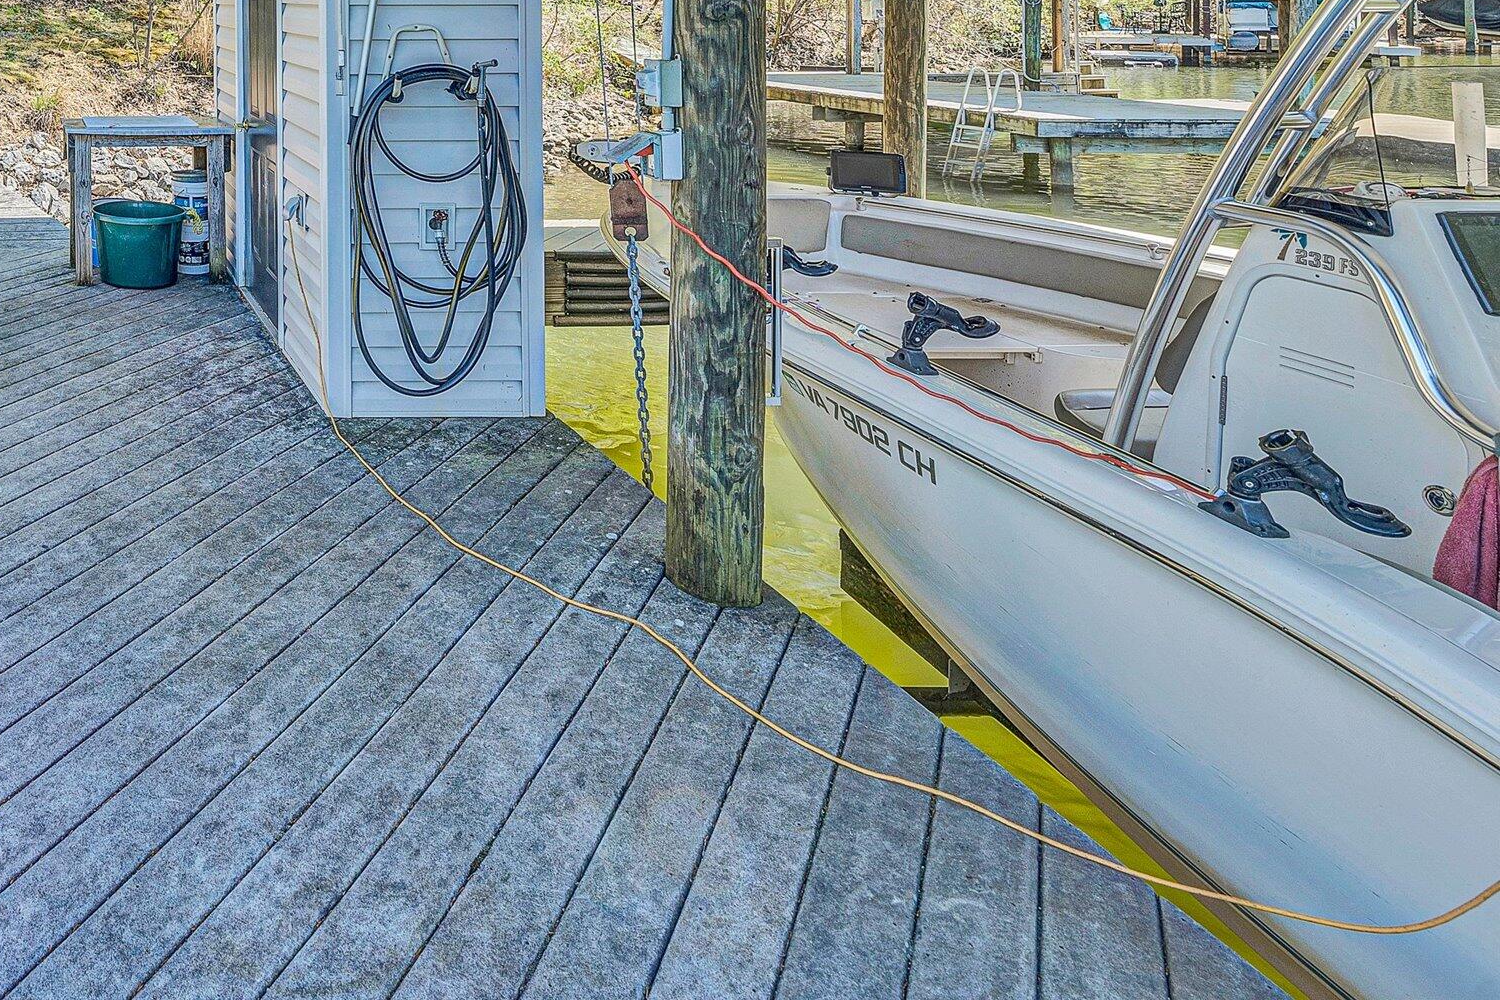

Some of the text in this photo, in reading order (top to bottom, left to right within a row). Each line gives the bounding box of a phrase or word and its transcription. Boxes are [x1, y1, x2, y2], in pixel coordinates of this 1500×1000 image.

[1294, 248, 1359, 277] 239 FS
[897, 440, 937, 486] CH
